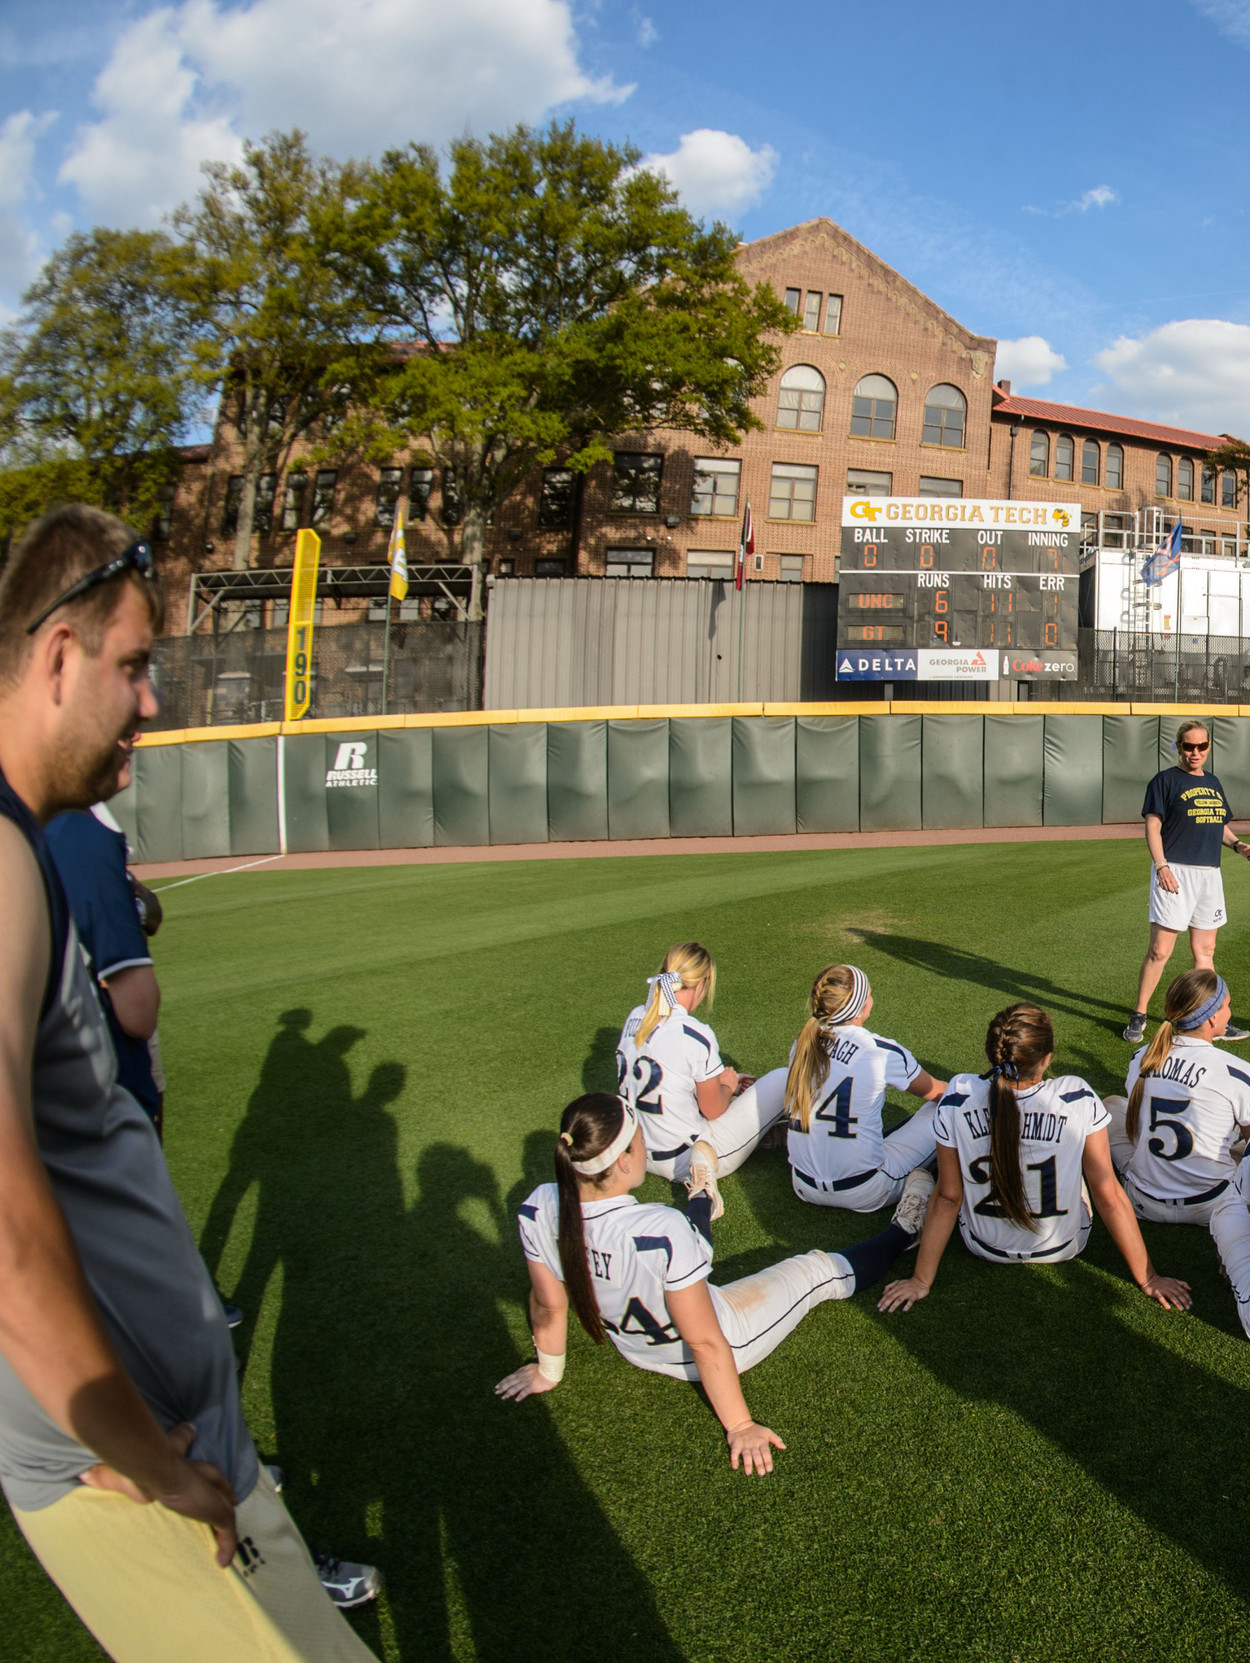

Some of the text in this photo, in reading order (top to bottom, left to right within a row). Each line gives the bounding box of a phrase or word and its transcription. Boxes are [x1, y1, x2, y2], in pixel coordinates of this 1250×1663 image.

[886, 503, 984, 522] GEORGIA
[989, 505, 1047, 524] TECH
[854, 528, 1068, 547] BALL STRIKE OUT INNING
[864, 544, 1058, 569] 0 0 0 7
[917, 573, 1065, 590] RUNS HITS ERR
[858, 593, 894, 609] UNC
[935, 590, 948, 613] 6
[991, 593, 1012, 612] 11
[862, 621, 1057, 645] GT 9 11 0
[293, 626, 306, 705] 190
[858, 658, 917, 671] DELTA
[929, 658, 969, 666] GEORGIA
[1012, 659, 1074, 672] Coke zero
[326, 768, 378, 781] RUSSELL
[325, 779, 377, 788] ATHLETIC
[1180, 787, 1216, 802] PROPERTY
[1187, 808, 1214, 817] GEORGIA
[1195, 815, 1223, 824] SOFTBALL
[1148, 1096, 1195, 1161] 5
[969, 1154, 1069, 1219] 21
